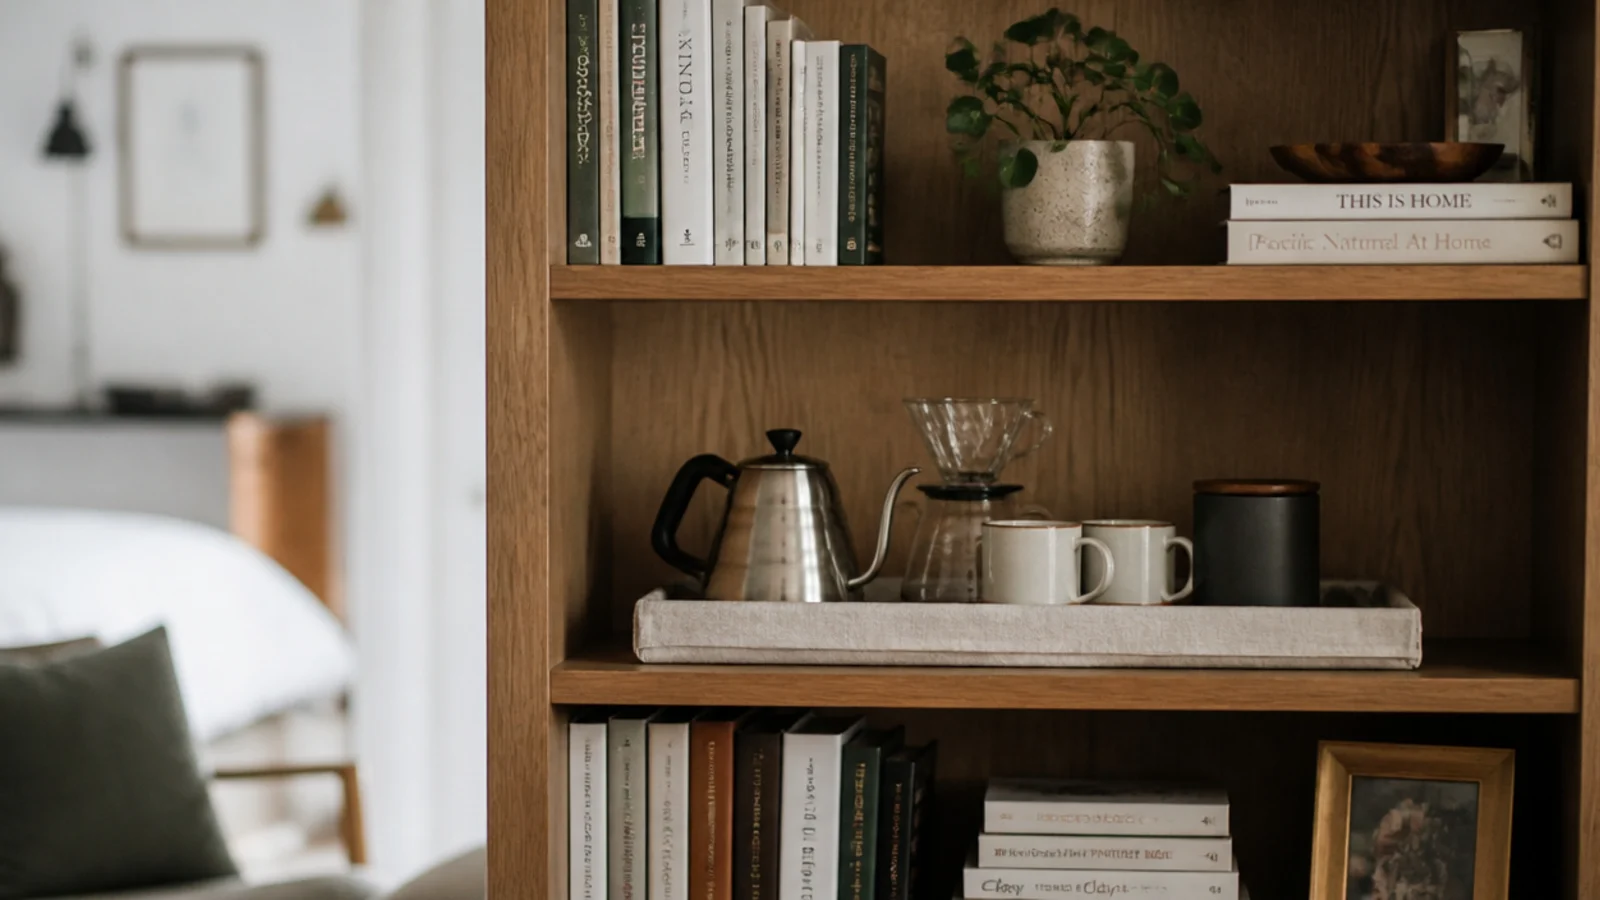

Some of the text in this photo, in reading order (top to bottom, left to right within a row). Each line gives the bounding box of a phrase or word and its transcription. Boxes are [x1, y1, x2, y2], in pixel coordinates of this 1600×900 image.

[1336, 193, 1472, 209] THIS IS HOME
[1406, 233, 1428, 250] At
[1434, 233, 1492, 250] Home
